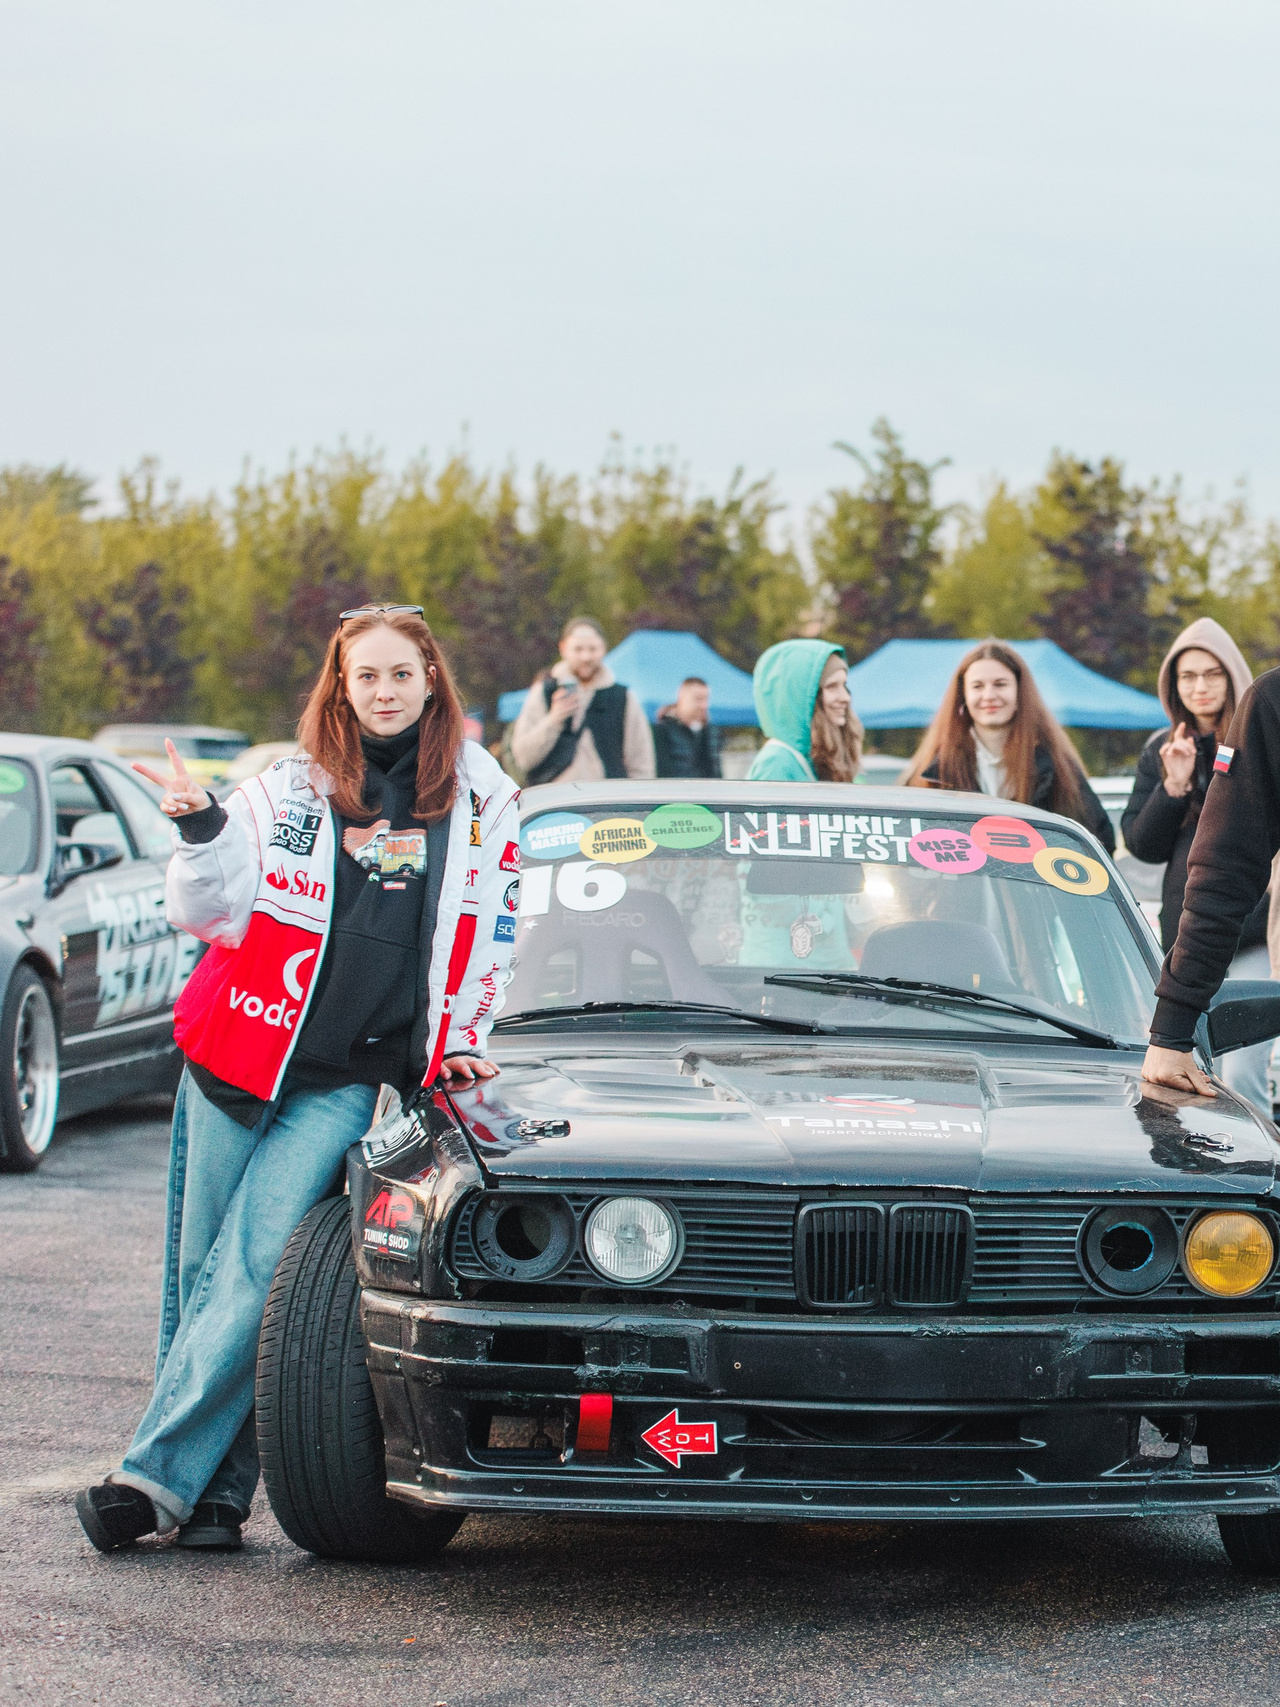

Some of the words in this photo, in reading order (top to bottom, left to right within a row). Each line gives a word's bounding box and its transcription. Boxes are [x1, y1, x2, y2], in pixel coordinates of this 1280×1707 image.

[310, 817, 319, 829] 1
[651, 825, 715, 836] CHALLENGE
[670, 819, 693, 828] 360
[272, 825, 313, 848] BOSS
[526, 822, 586, 842] PARKING
[594, 827, 642, 842] AFRICAN
[270, 837, 288, 846] UGO
[591, 838, 648, 855] SPINNING
[819, 831, 913, 863] FEST
[916, 838, 972, 852] KISS
[934, 850, 970, 864] ME
[519, 860, 627, 918] 16
[764, 1116, 984, 1134] Tamashi
[860, 1129, 952, 1140] technology
[364, 1228, 389, 1246] TUNING
[388, 1233, 410, 1251] SHOP
[656, 1428, 710, 1449] TOW
